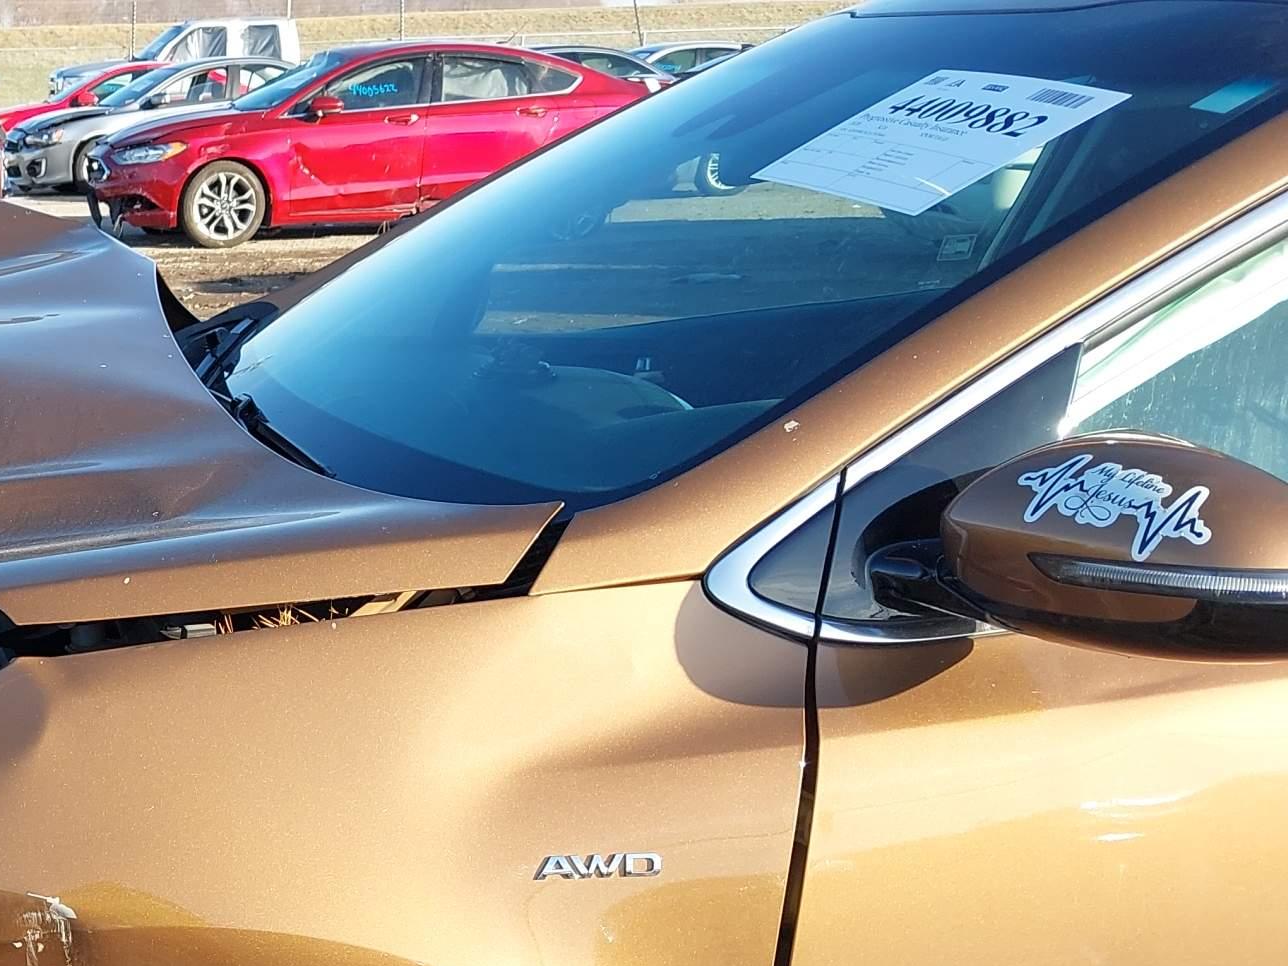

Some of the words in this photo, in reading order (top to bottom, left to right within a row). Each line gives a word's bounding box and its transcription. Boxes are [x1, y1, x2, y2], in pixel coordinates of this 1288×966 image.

[887, 94, 1049, 138] 44009882
[1090, 465, 1122, 484] My
[1120, 471, 1166, 495] Lifeline
[1070, 483, 1134, 516] Jesus
[532, 852, 663, 881] AWD
